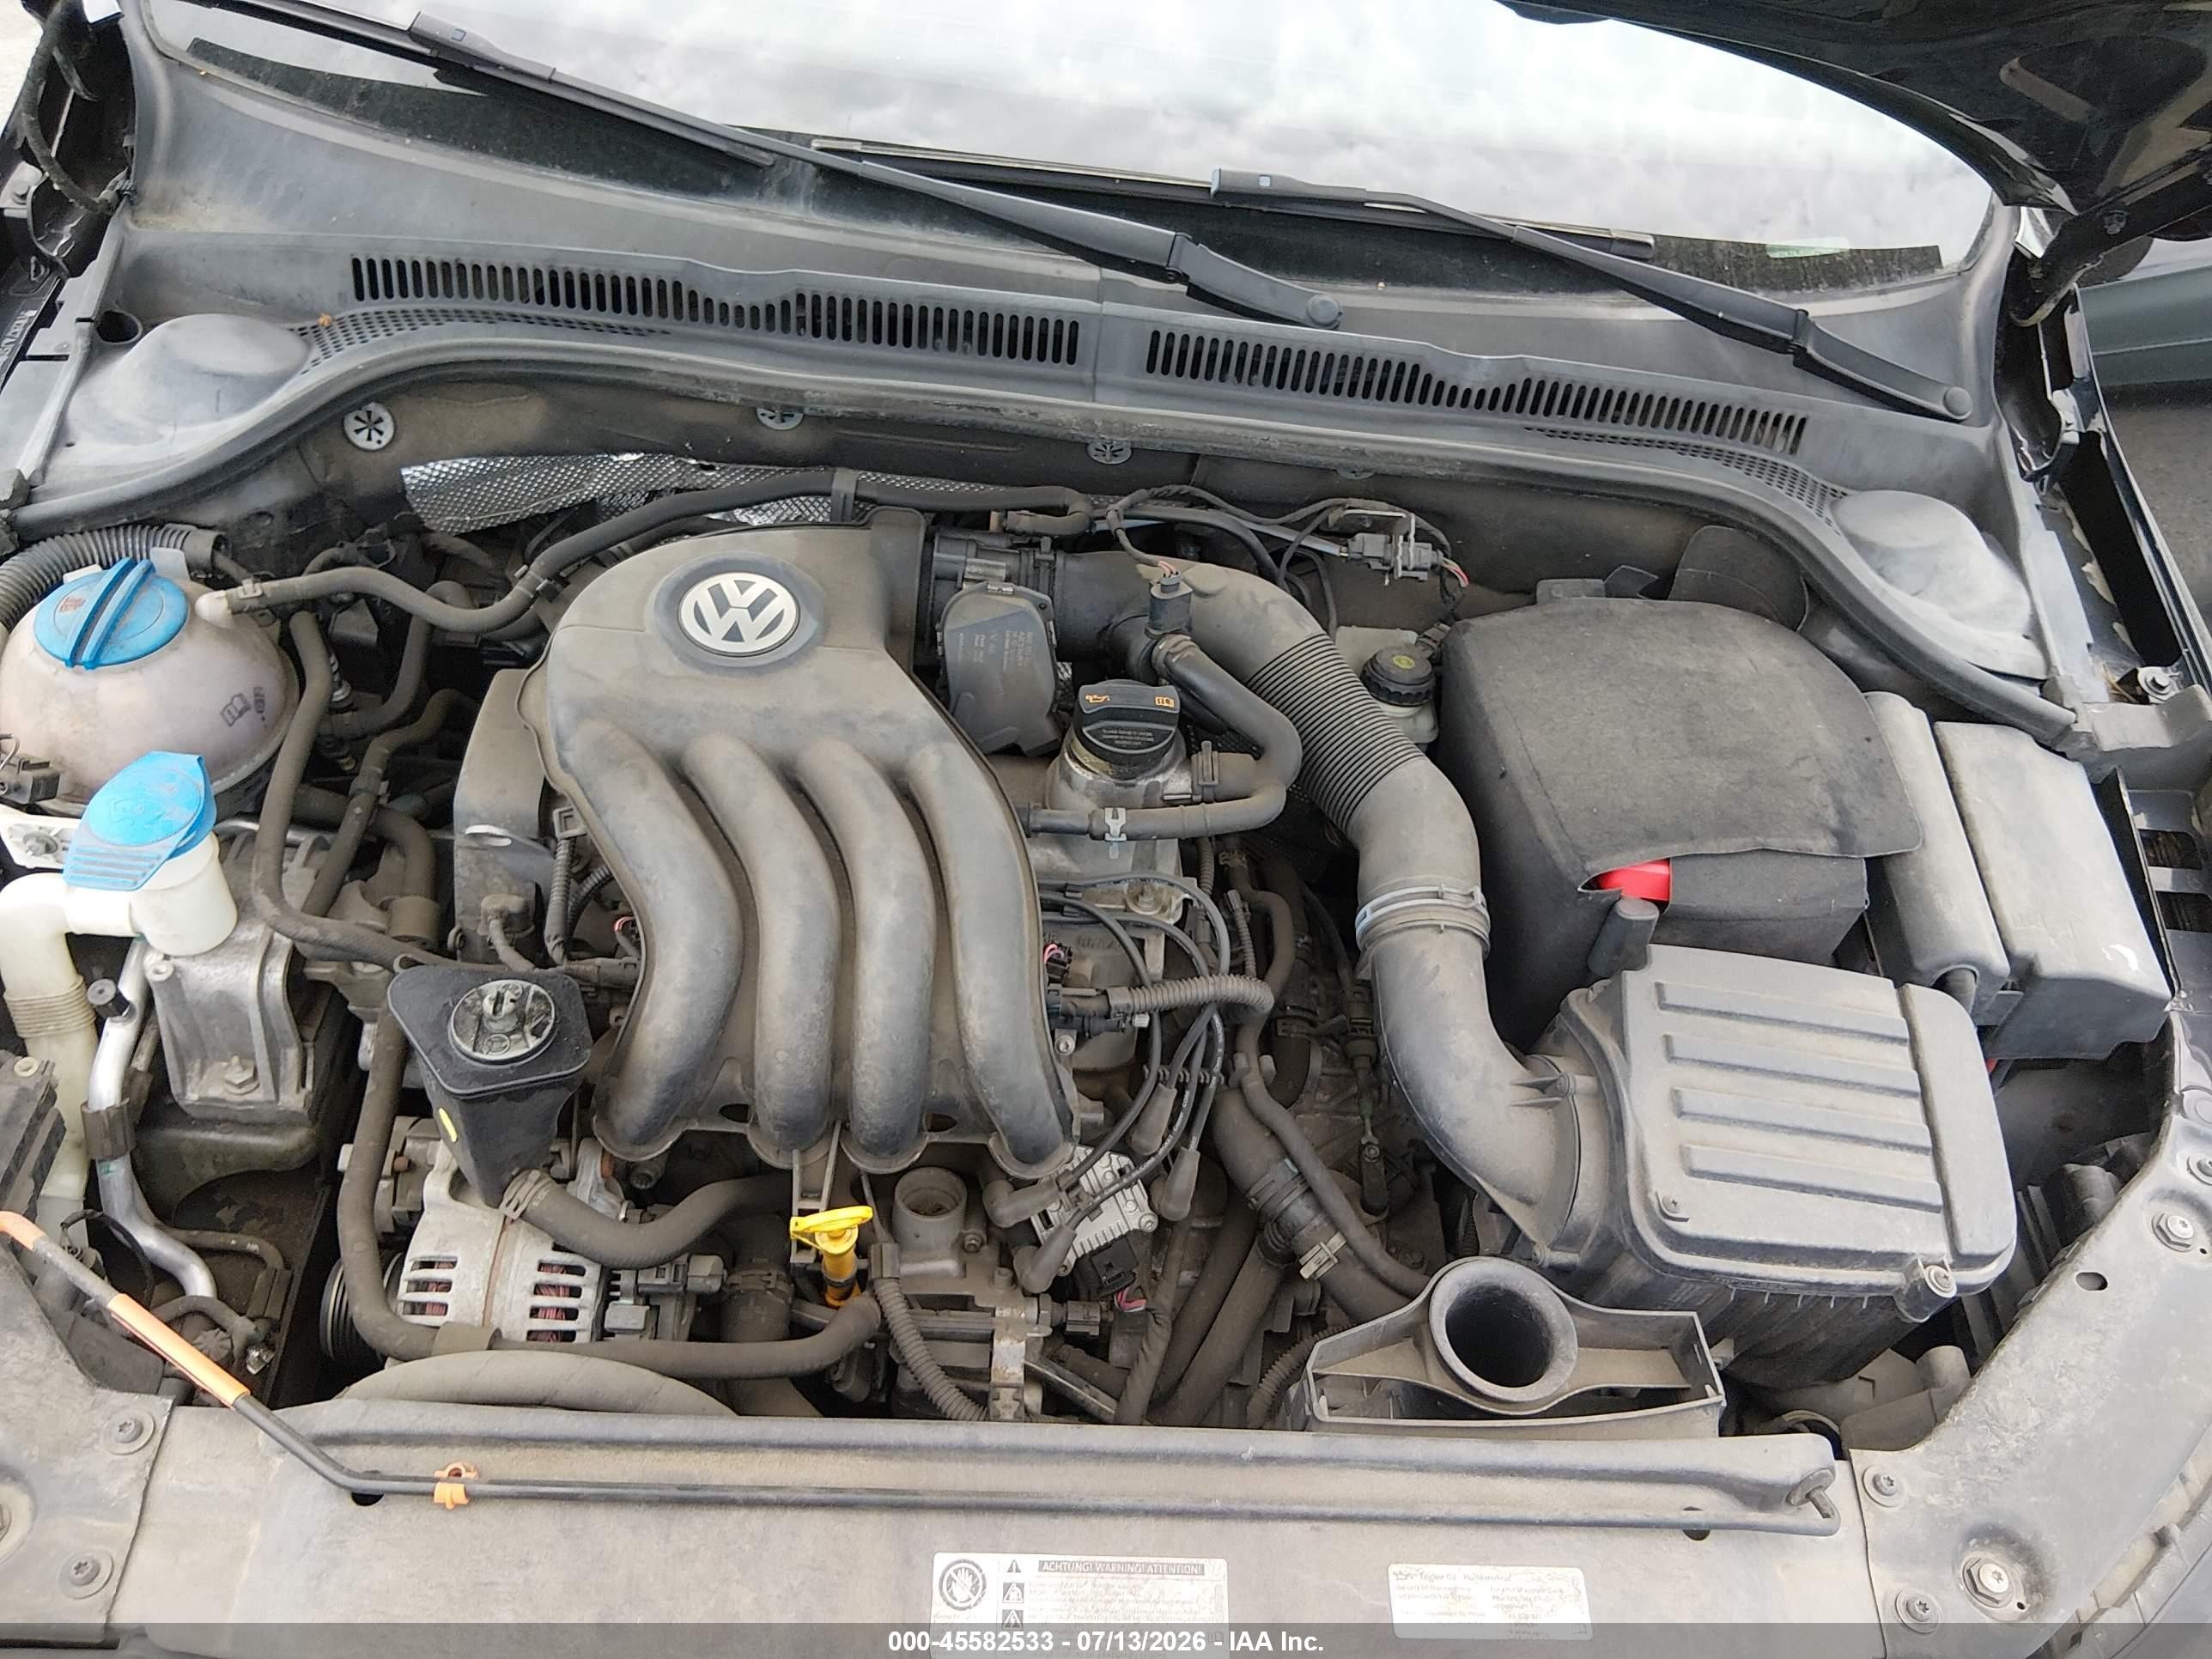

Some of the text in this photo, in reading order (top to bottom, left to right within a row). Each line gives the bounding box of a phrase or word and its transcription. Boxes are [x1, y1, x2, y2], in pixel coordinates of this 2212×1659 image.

[1042, 1561, 1202, 1575] ACHTUNG! WARNING! ATTENTION!
